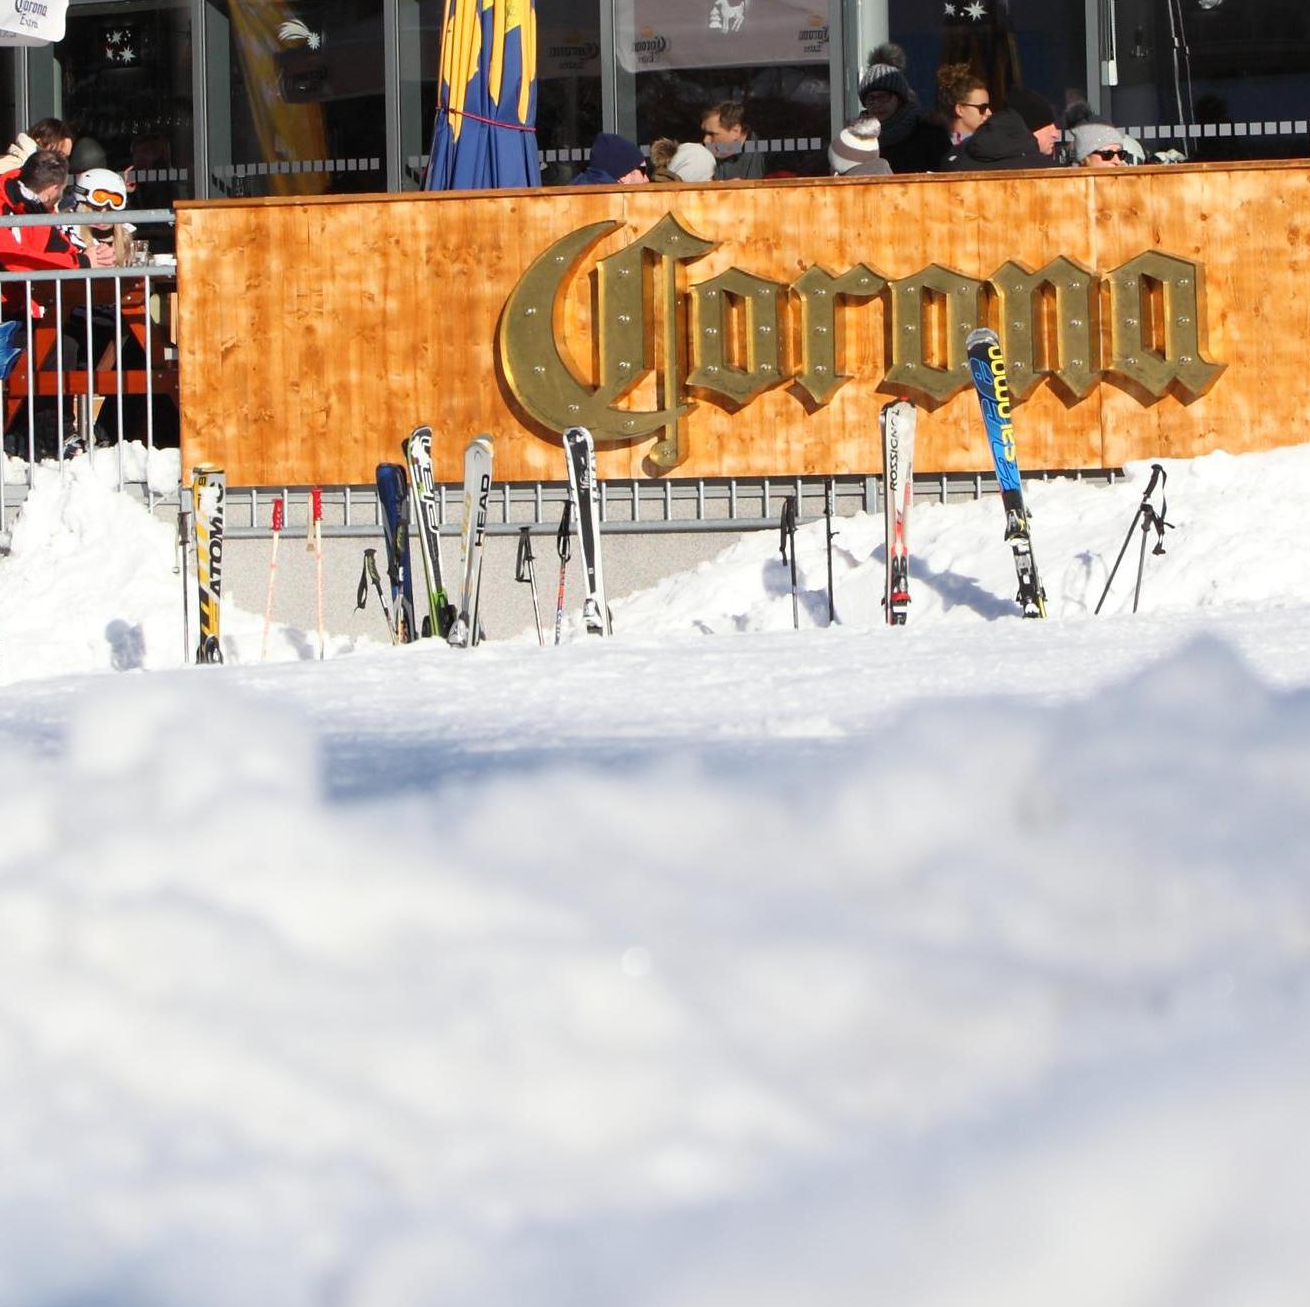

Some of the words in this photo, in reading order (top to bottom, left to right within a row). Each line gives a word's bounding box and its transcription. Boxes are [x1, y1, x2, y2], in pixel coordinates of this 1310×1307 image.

[498, 211, 1228, 467] Corona
[988, 346, 1016, 462] salomon
[209, 481, 224, 599] ATOMC
[475, 474, 490, 547] HEAD
